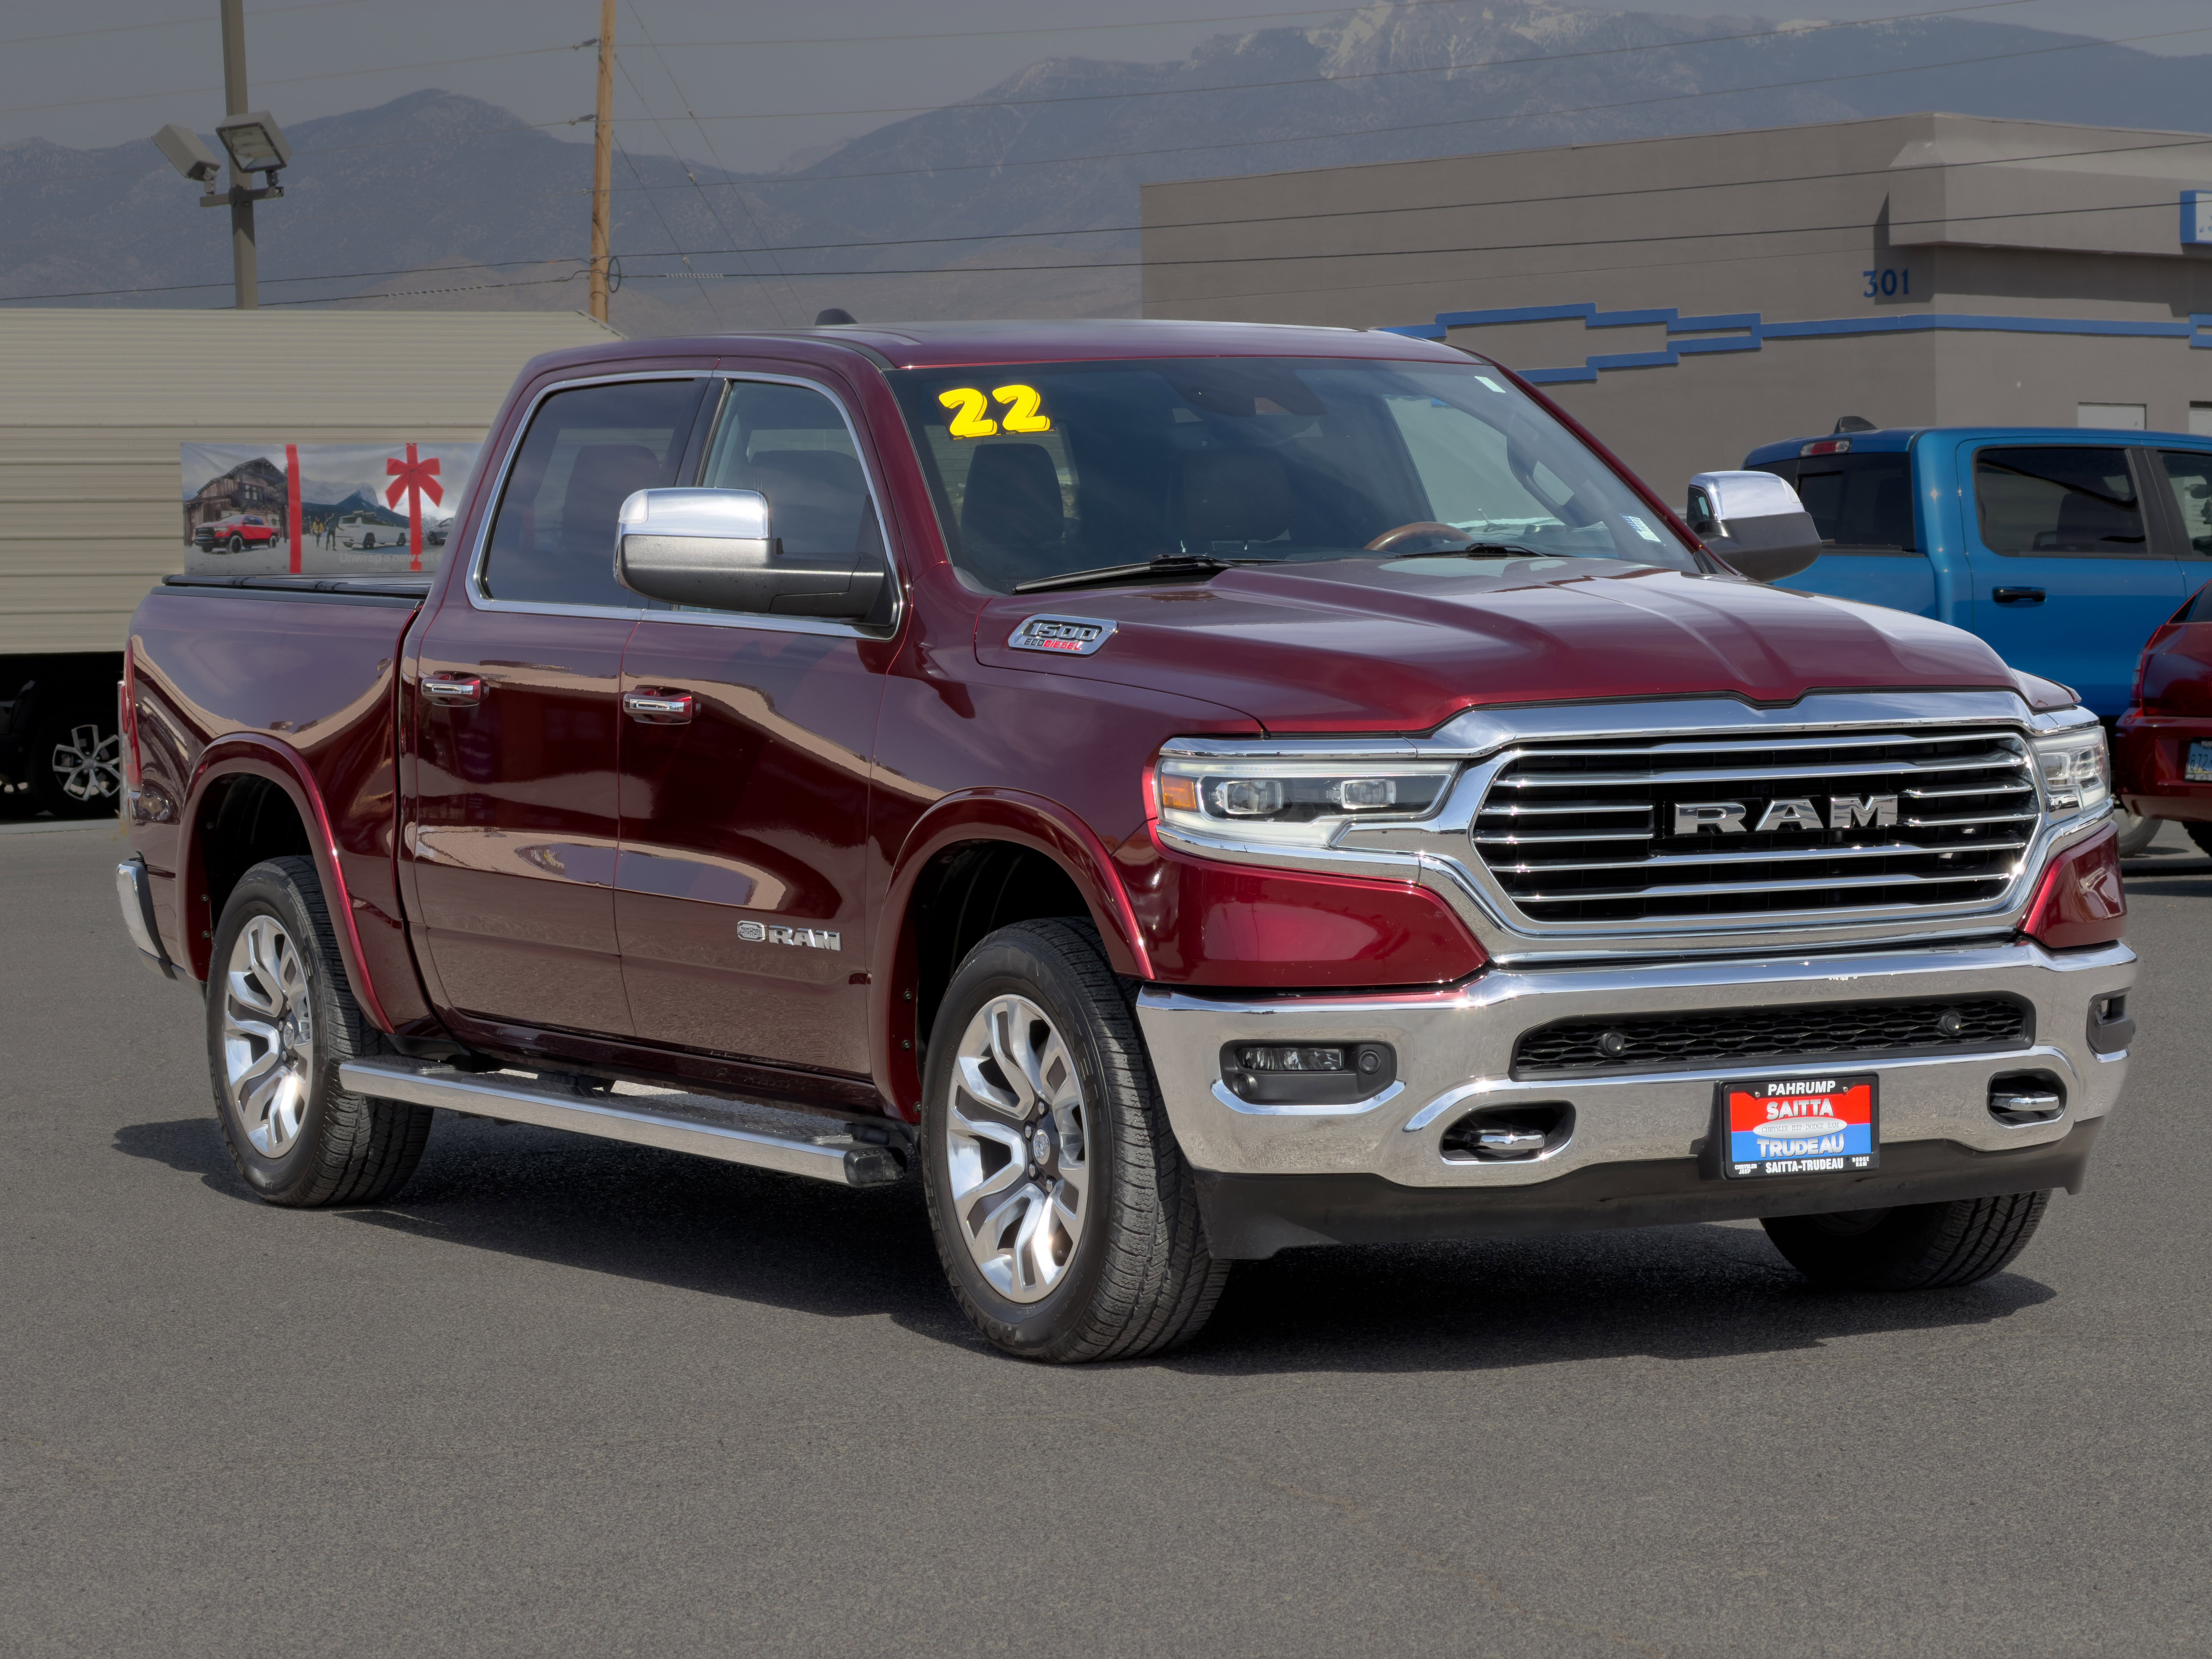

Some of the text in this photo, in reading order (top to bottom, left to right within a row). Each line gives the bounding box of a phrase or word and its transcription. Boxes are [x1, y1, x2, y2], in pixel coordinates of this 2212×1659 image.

[1863, 268, 1909, 298] 301
[939, 385, 1051, 437] 22
[339, 553, 381, 564] Unwrap
[418, 553, 434, 562] set
[1030, 622, 1099, 640] 1500
[1023, 638, 1083, 651] ECODIESEL
[1674, 793, 1898, 836] RAM
[769, 925, 841, 951] RAM
[1768, 1080, 1836, 1096] PAHRUMP
[1767, 1098, 1835, 1120] SAITTA
[1757, 1133, 1844, 1158] TRUDEAU
[1765, 1157, 1844, 1174] SAITTA-TRUDEAU
